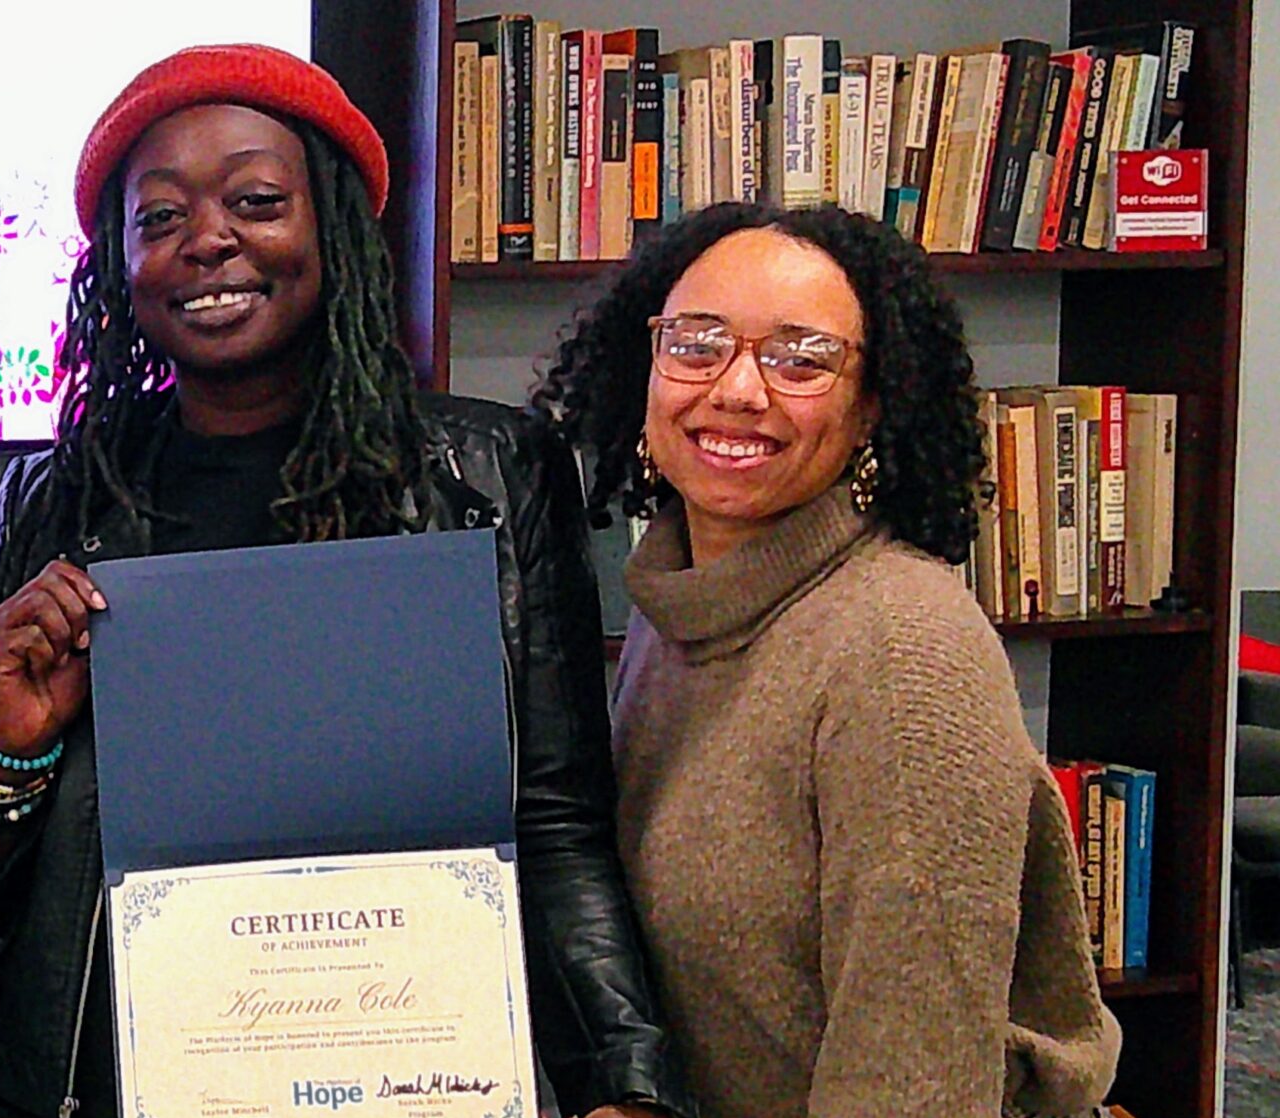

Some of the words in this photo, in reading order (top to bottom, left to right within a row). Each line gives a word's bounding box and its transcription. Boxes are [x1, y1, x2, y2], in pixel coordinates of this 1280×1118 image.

[568, 45, 579, 70] WHO
[787, 58, 801, 77] The
[568, 75, 579, 106] OWNS
[874, 63, 890, 109] TRAIL
[1091, 59, 1105, 98] GOOD
[567, 110, 578, 156] HISTORY
[585, 115, 595, 153] American
[741, 79, 754, 157] disturbers
[1084, 102, 1099, 139] TIMES
[871, 123, 886, 170] TEARS
[1080, 142, 1091, 169] PETER
[742, 160, 754, 174] of
[824, 142, 832, 193] CHANGE
[1074, 170, 1086, 207] JOSEPH
[1120, 195, 1139, 205] Get
[1141, 194, 1198, 204] Connected
[231, 908, 405, 936] CERTIFICATE
[261, 942, 276, 952] OF
[281, 937, 368, 951] ACHIEVEMENT
[329, 963, 371, 971] Presented
[218, 987, 341, 1031] Kyanna
[358, 977, 418, 1014] Cole
[293, 1081, 363, 1110] Hope
